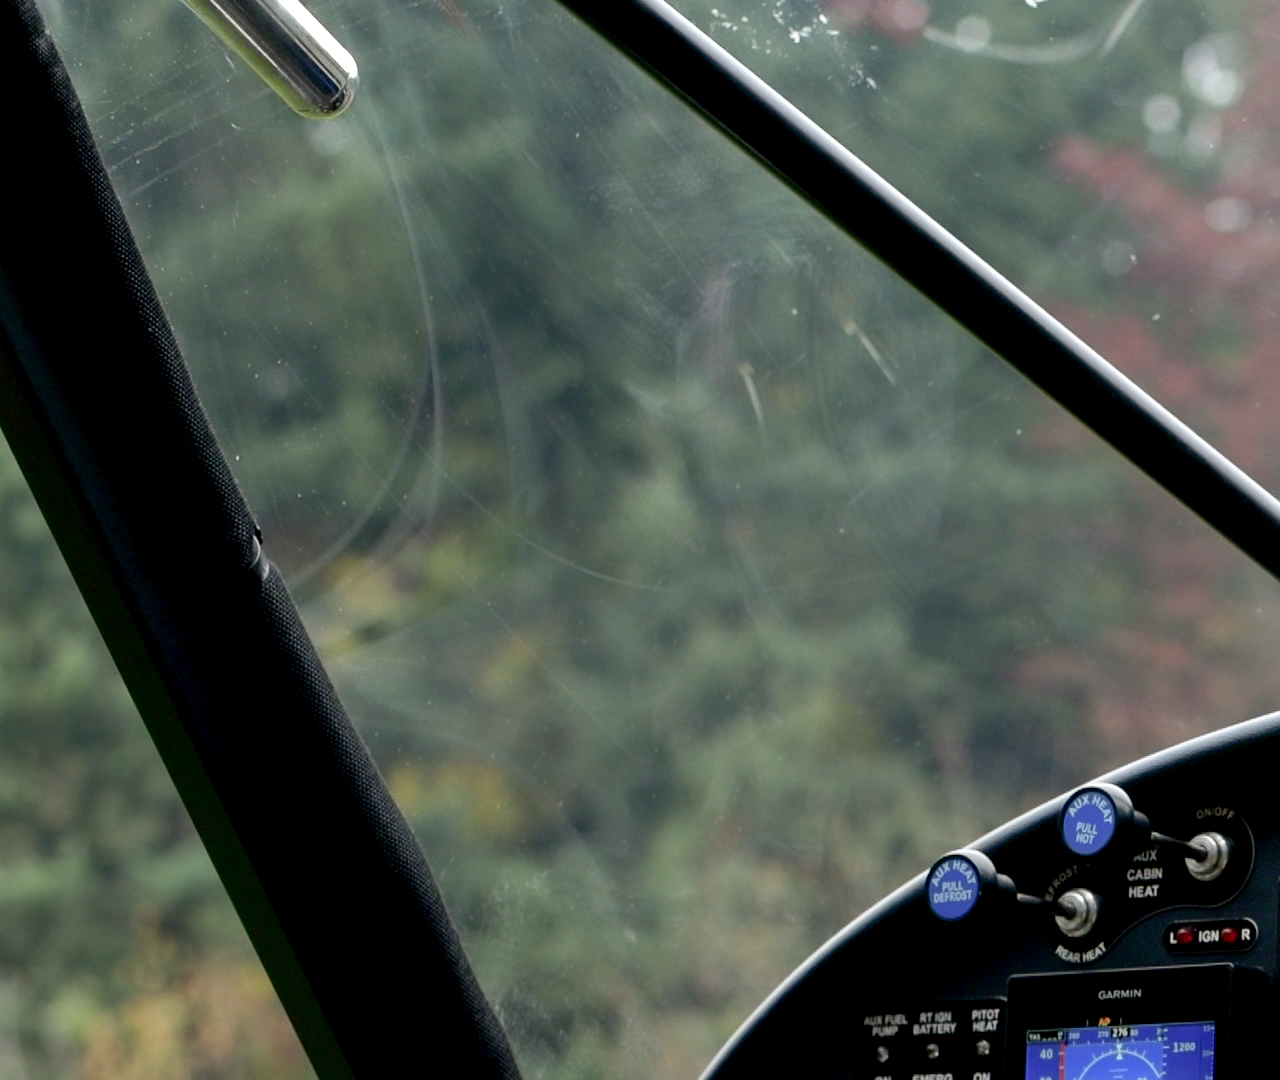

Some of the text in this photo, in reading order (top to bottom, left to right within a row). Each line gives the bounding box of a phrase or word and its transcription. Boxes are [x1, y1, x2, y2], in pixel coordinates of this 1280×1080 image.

[1069, 795, 1112, 824] AUX HEAT
[1076, 833, 1095, 844] HOT
[1127, 868, 1163, 881] CABIN
[933, 889, 973, 903] DEFROST
[1128, 884, 1160, 898] HEAT
[1198, 929, 1219, 943] IGN
[1098, 989, 1143, 1000] GARMIN
[971, 1008, 1000, 1021] PITOT
[912, 1021, 957, 1036] BATTERY
[972, 1020, 999, 1032] HEAT
[1172, 1042, 1196, 1053] 1200
